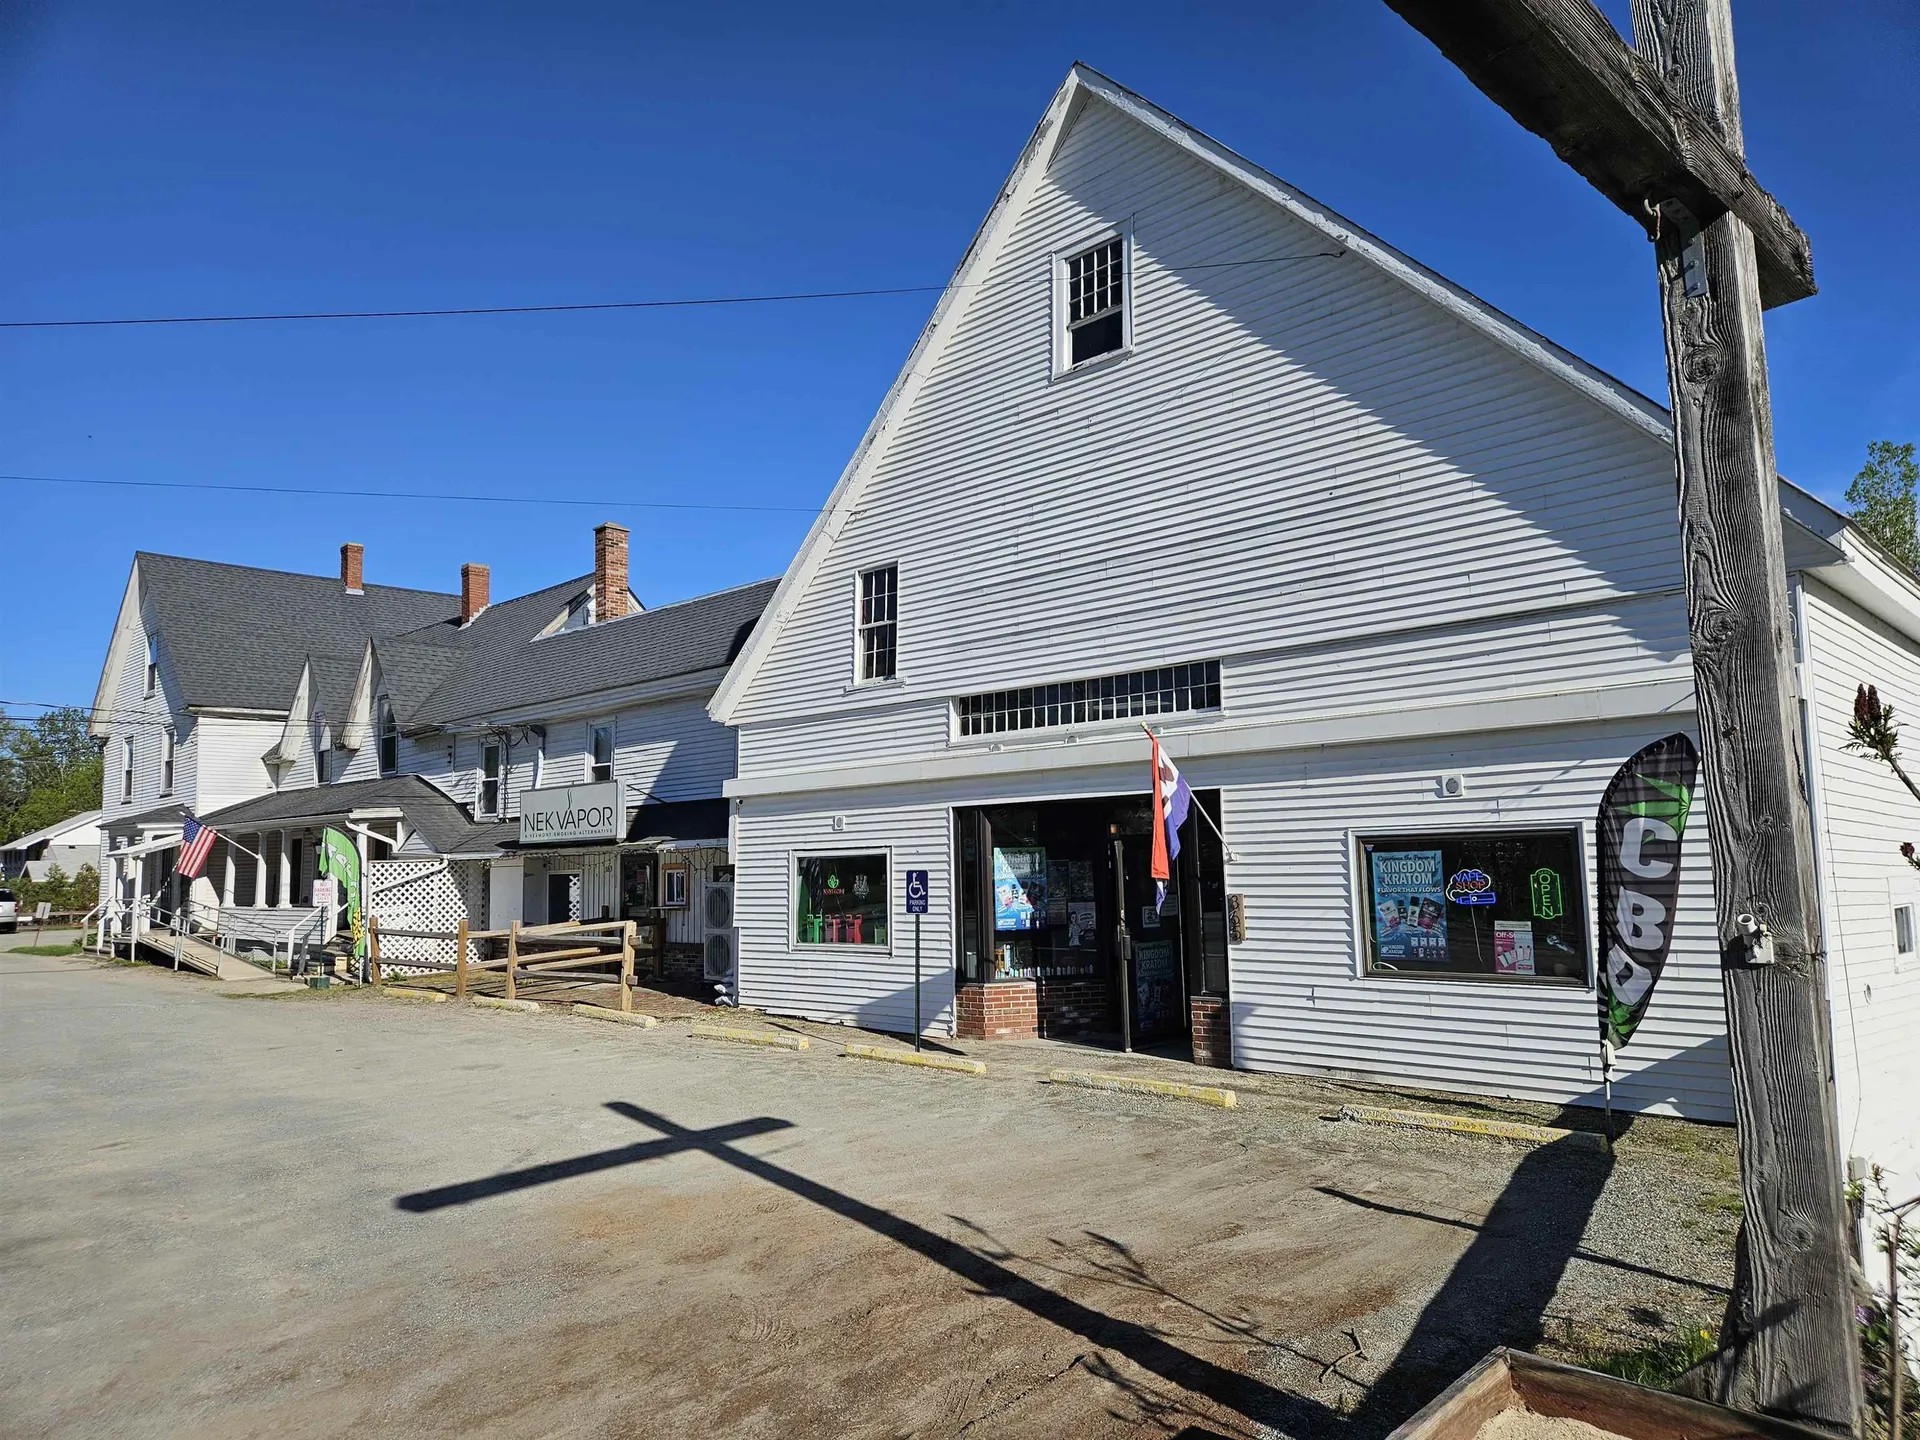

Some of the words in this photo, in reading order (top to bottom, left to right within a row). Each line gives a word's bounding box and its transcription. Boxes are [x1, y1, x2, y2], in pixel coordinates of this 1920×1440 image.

[524, 811, 555, 832] NEK
[555, 806, 614, 830] VAPOR
[1380, 860, 1436, 873] KINGDOM
[1385, 872, 1433, 885] KRATOM
[1454, 872, 1485, 882] VAPE
[1455, 880, 1486, 890] SHOP
[1539, 873, 1554, 917] OPEN
[1607, 817, 1678, 1006] CBD
[1138, 948, 1170, 960] KINGDOM
